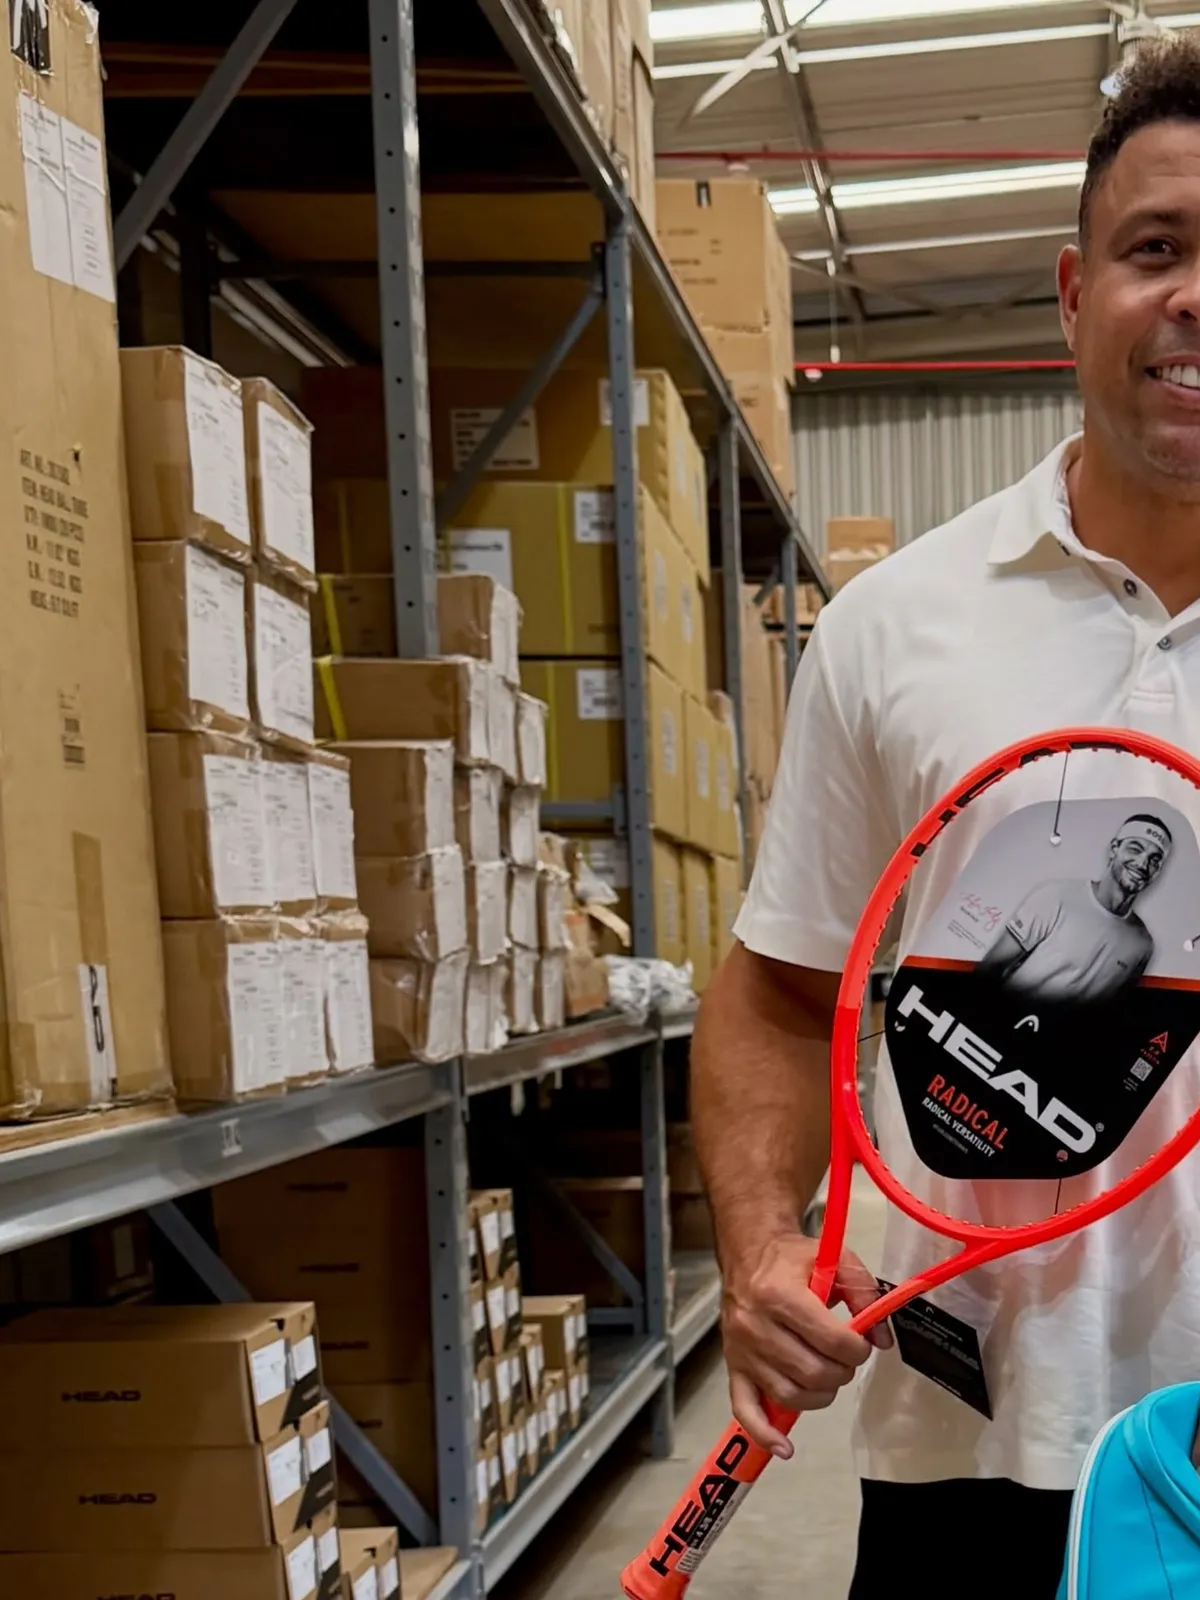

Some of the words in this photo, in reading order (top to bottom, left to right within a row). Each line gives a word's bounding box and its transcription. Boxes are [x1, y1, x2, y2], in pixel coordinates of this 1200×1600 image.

[897, 984, 1096, 1154] HEAD
[922, 1096, 952, 1126] RADICAL
[951, 1120, 996, 1158] VERSATILITY
[926, 1074, 1009, 1149] RADICAL
[61, 1390, 142, 1403] HEAD
[78, 1493, 157, 1505] HEAD
[649, 1434, 750, 1577] HEAD
